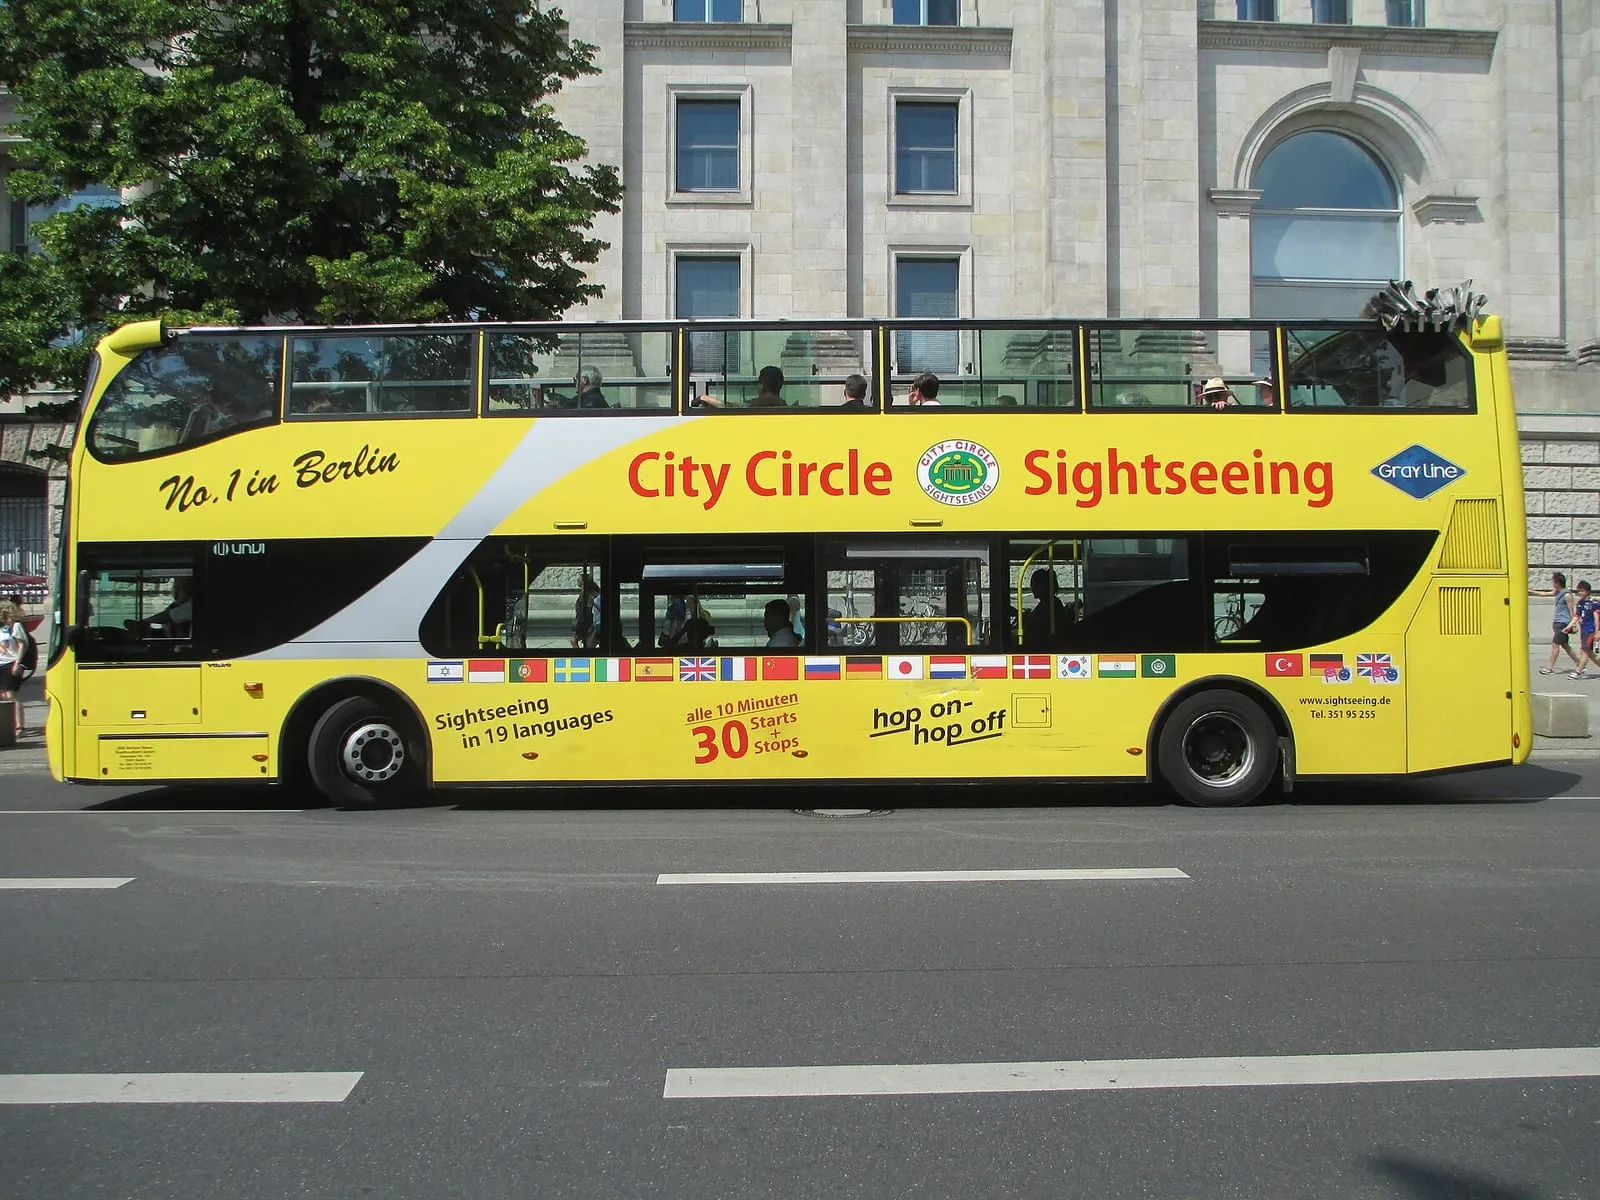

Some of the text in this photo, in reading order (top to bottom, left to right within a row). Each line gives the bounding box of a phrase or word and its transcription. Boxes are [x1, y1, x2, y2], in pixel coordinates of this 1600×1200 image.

[246, 469, 280, 497] in
[293, 444, 401, 489] Berlin
[628, 447, 1334, 511] City Circle Sightseeing
[924, 482, 992, 505] SIGHTSEEING
[435, 697, 550, 731] Sightseeing
[686, 692, 799, 723] alle 10 Minuten
[873, 699, 974, 731] hop on-
[1299, 696, 1391, 707] www.sightseeing.de
[1310, 710, 1376, 719] Tel. 351 95 255
[461, 709, 614, 749] in 19 languages
[750, 711, 798, 730] Starts
[914, 709, 1007, 747] hop off
[691, 719, 749, 765] 30
[754, 736, 800, 755] Stops
